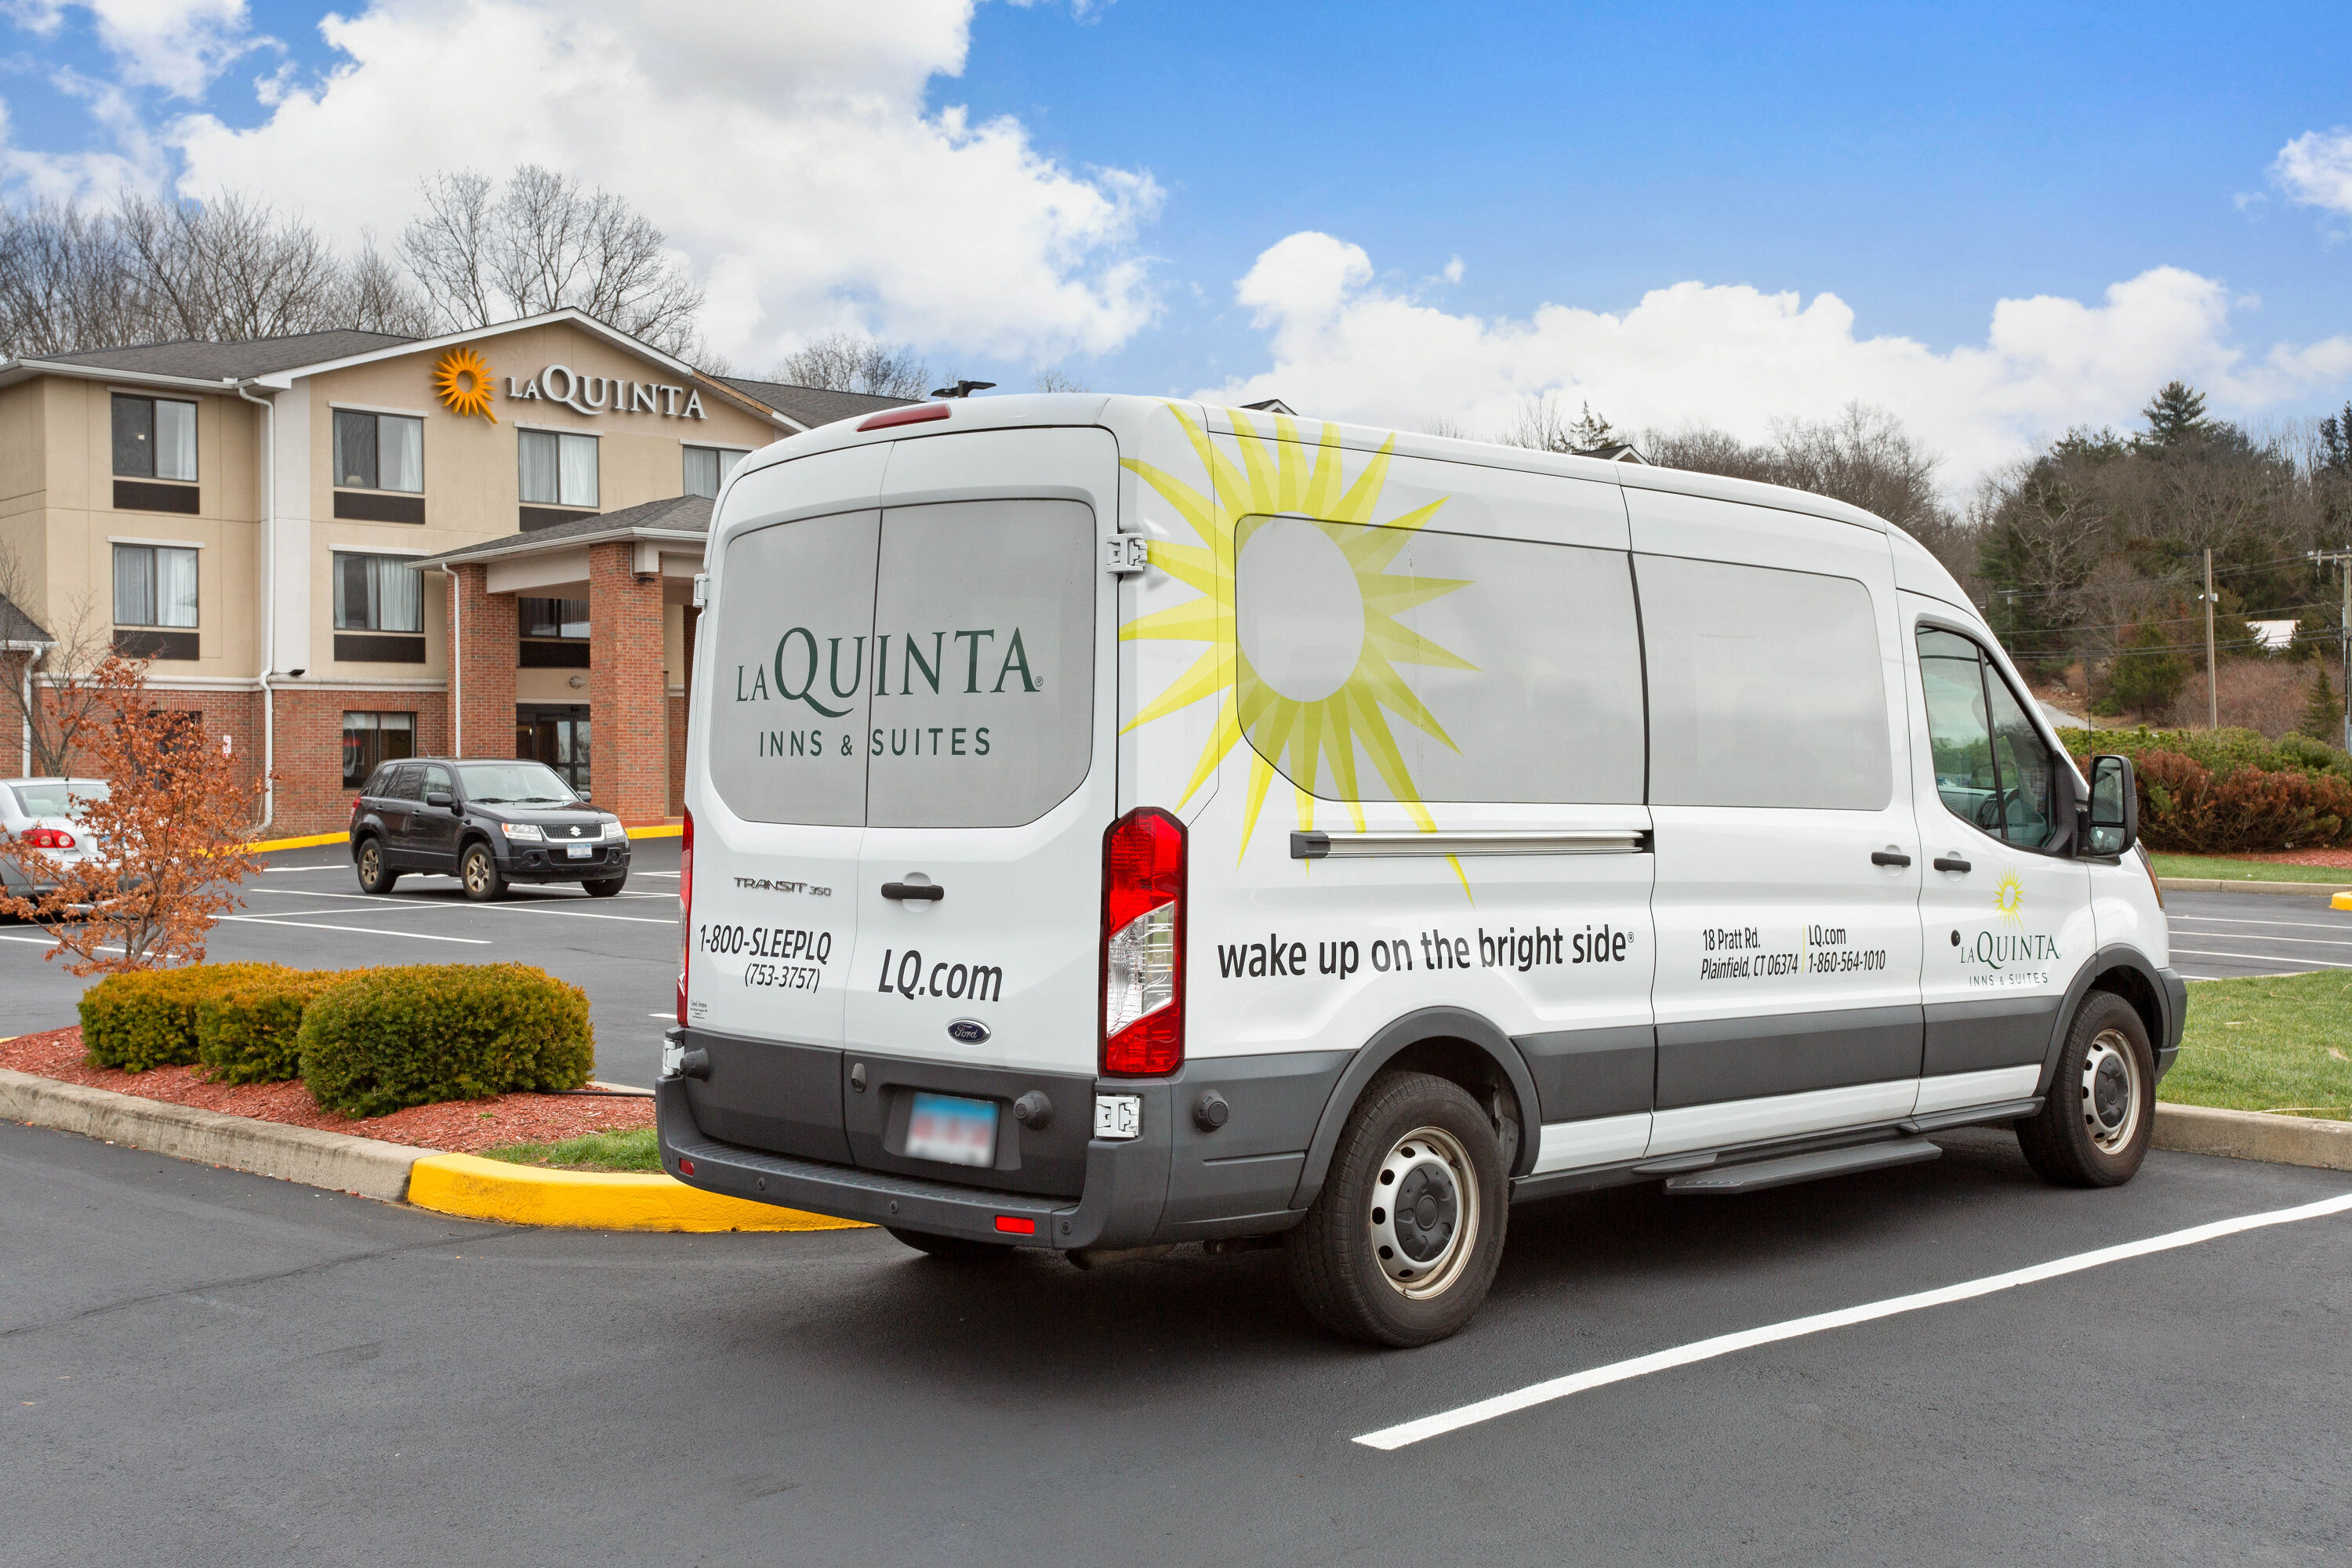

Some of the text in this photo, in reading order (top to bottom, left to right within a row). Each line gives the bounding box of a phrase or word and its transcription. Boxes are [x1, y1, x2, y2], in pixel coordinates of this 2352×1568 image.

[508, 365, 709, 419] LA QUINTA
[736, 663, 771, 702] LA
[760, 727, 990, 757] INNS & SUITES
[734, 877, 832, 897] TRANSIT 350
[700, 924, 832, 965] 1-800-SLEEPLQ
[1703, 927, 1761, 951] 18 Pratt Rd.
[1808, 924, 1846, 947] LQ.com
[1218, 933, 1307, 978] wake
[1319, 939, 1359, 980] up
[1370, 940, 1413, 972] on
[1421, 929, 1471, 970] the
[1478, 927, 1563, 972] bright
[1700, 953, 1798, 980] Plainfield, CT 06374
[1809, 949, 1886, 973] 1-860-564-1010
[1960, 946, 1975, 964] LA
[745, 962, 820, 994] (753-3757)
[878, 949, 1003, 1002] LQ.com
[1969, 972, 2049, 987] INNS & SUITES
[954, 1024, 978, 1039] Ford
